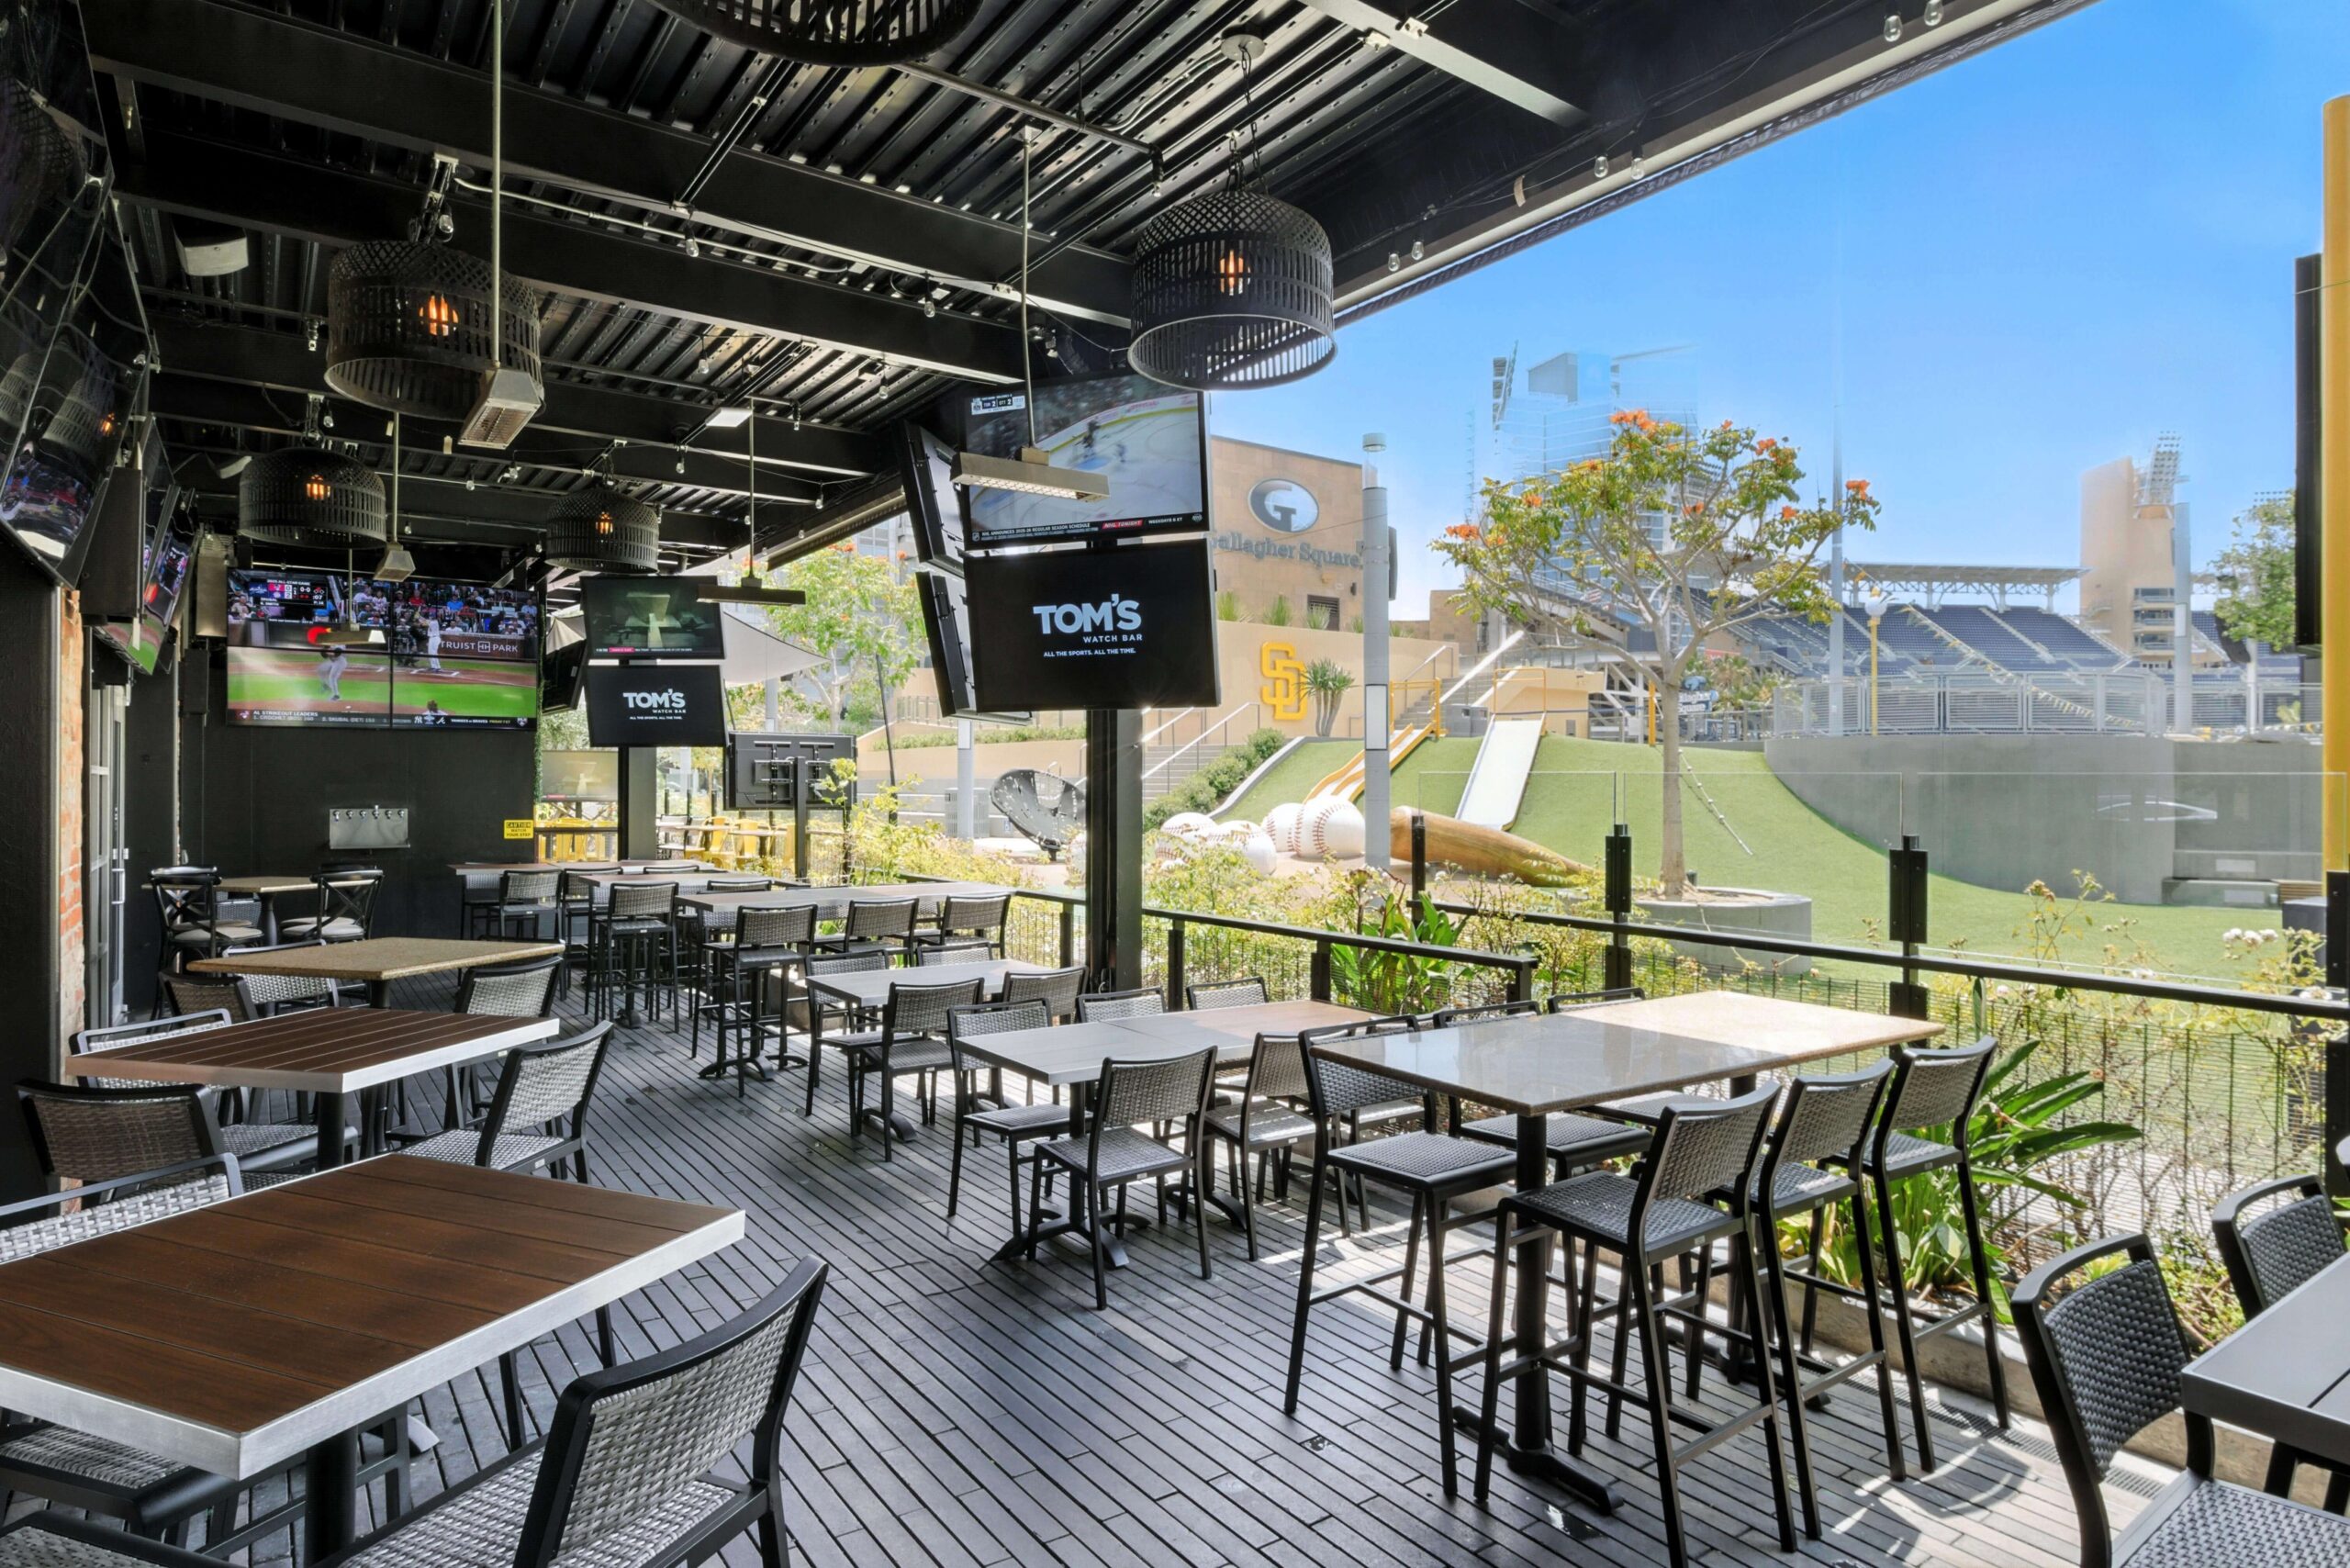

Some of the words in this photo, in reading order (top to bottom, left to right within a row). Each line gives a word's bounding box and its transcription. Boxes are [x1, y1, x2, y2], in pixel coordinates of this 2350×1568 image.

[1209, 530, 1295, 559] allagher
[1033, 593, 1142, 634] TOM'S
[441, 641, 476, 650] TRUIST
[1122, 633, 1143, 642] BAR
